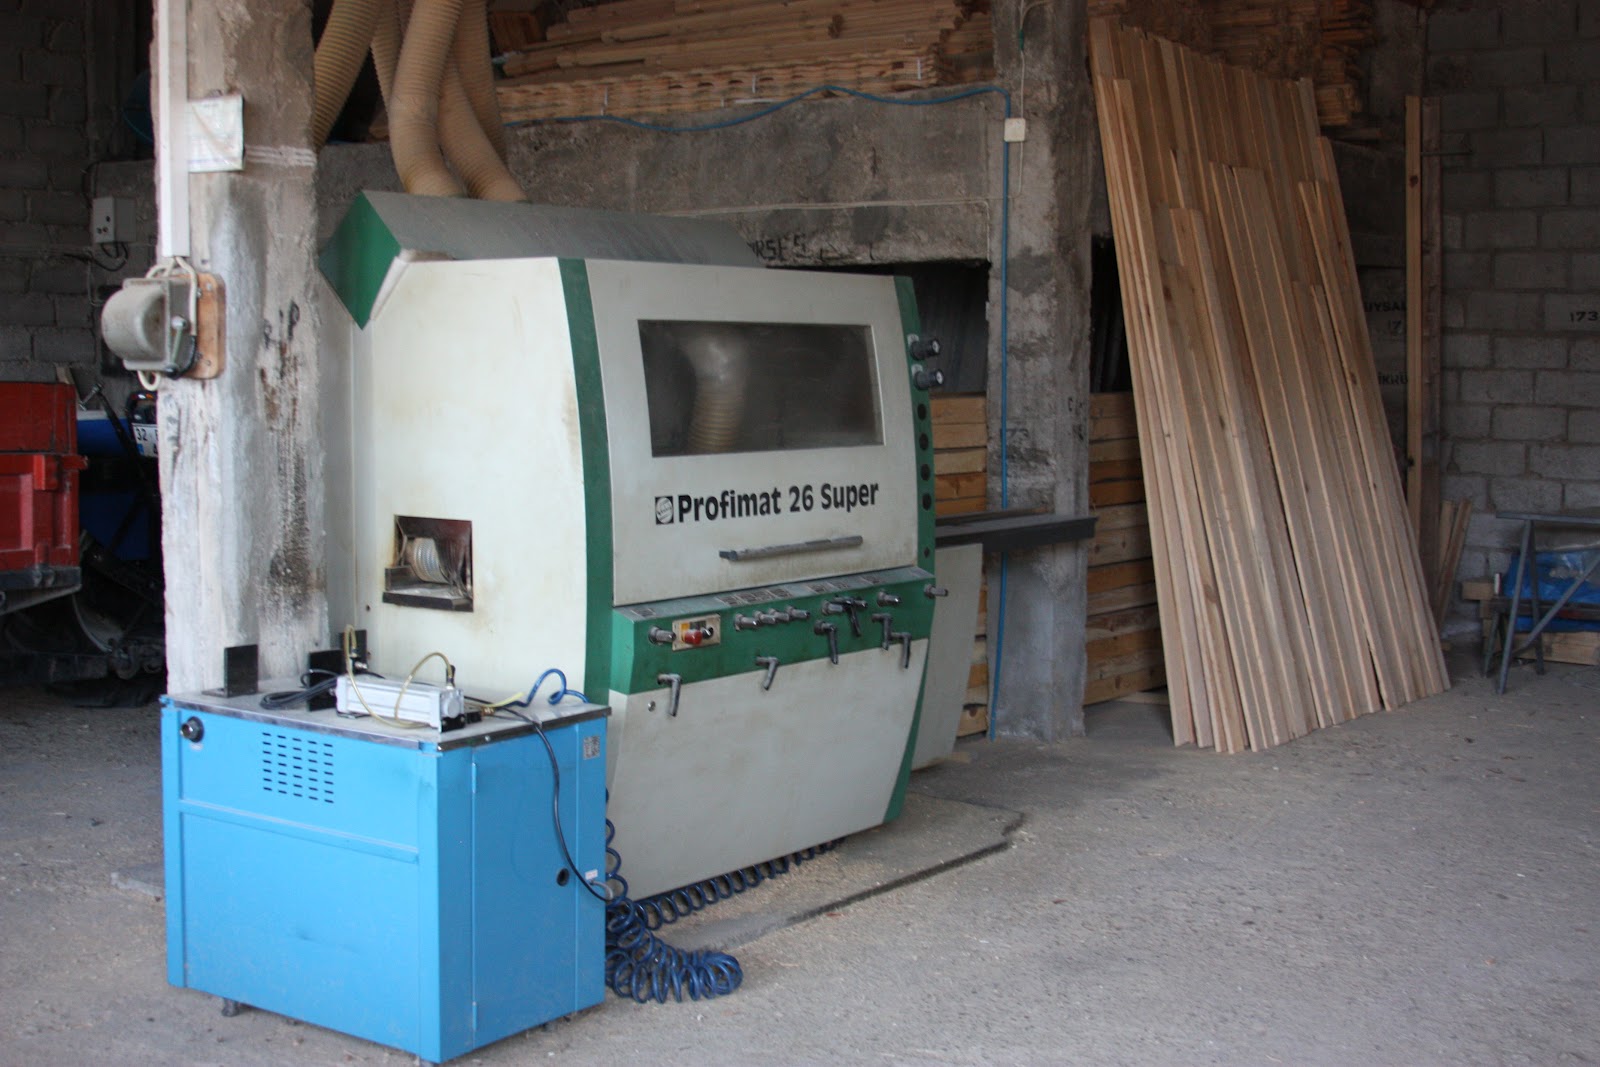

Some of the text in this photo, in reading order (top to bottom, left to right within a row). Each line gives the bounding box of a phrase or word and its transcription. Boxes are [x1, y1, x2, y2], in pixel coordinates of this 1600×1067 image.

[678, 482, 879, 523] Profimat 26 Super
